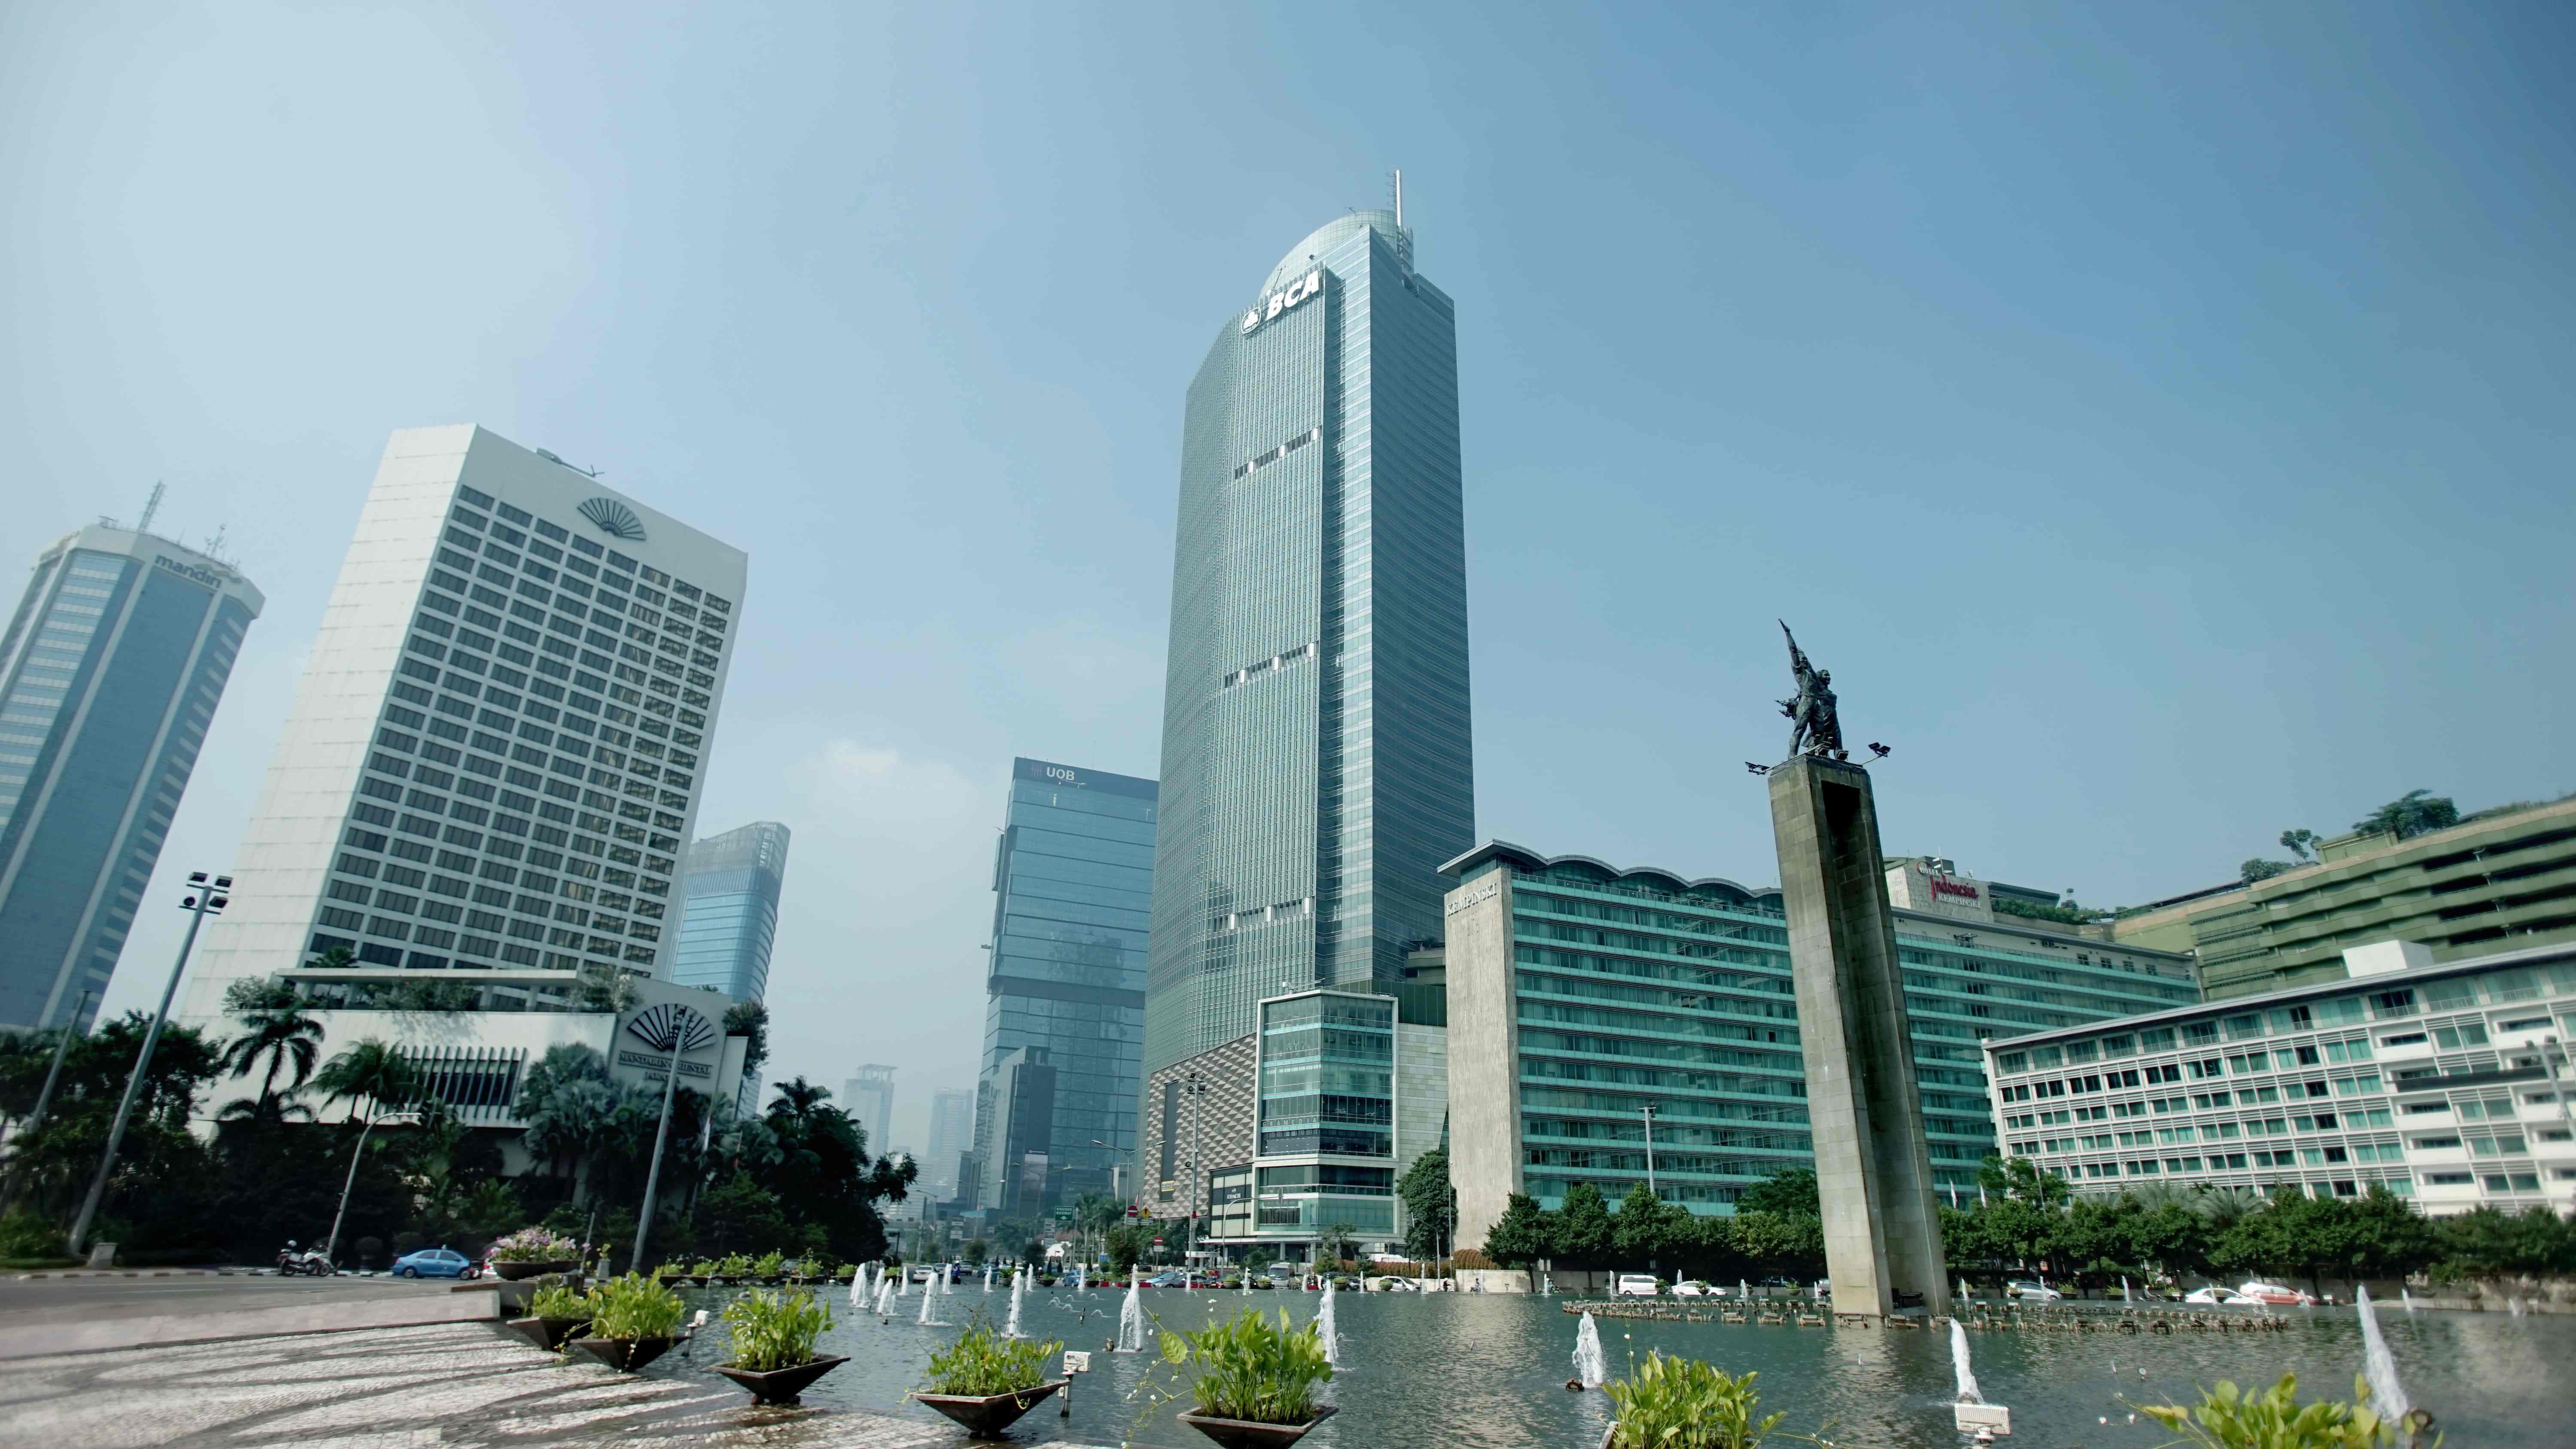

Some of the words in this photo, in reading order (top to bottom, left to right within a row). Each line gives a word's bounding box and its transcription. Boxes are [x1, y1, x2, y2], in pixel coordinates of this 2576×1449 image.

[1267, 270, 1319, 321] BCA
[155, 555, 222, 589] mandiri
[1046, 767, 1075, 781] UOB
[1920, 867, 1938, 876] HOTEL
[1930, 873, 1979, 901] Indonesia
[1446, 882, 1497, 916] KEMPINSKI
[1938, 893, 1981, 909] KEMPINSKI
[618, 1053, 668, 1069] MANDARIN
[668, 1060, 711, 1074] OIENTAL
[1262, 1118, 1317, 1127] GRAMEDIA
